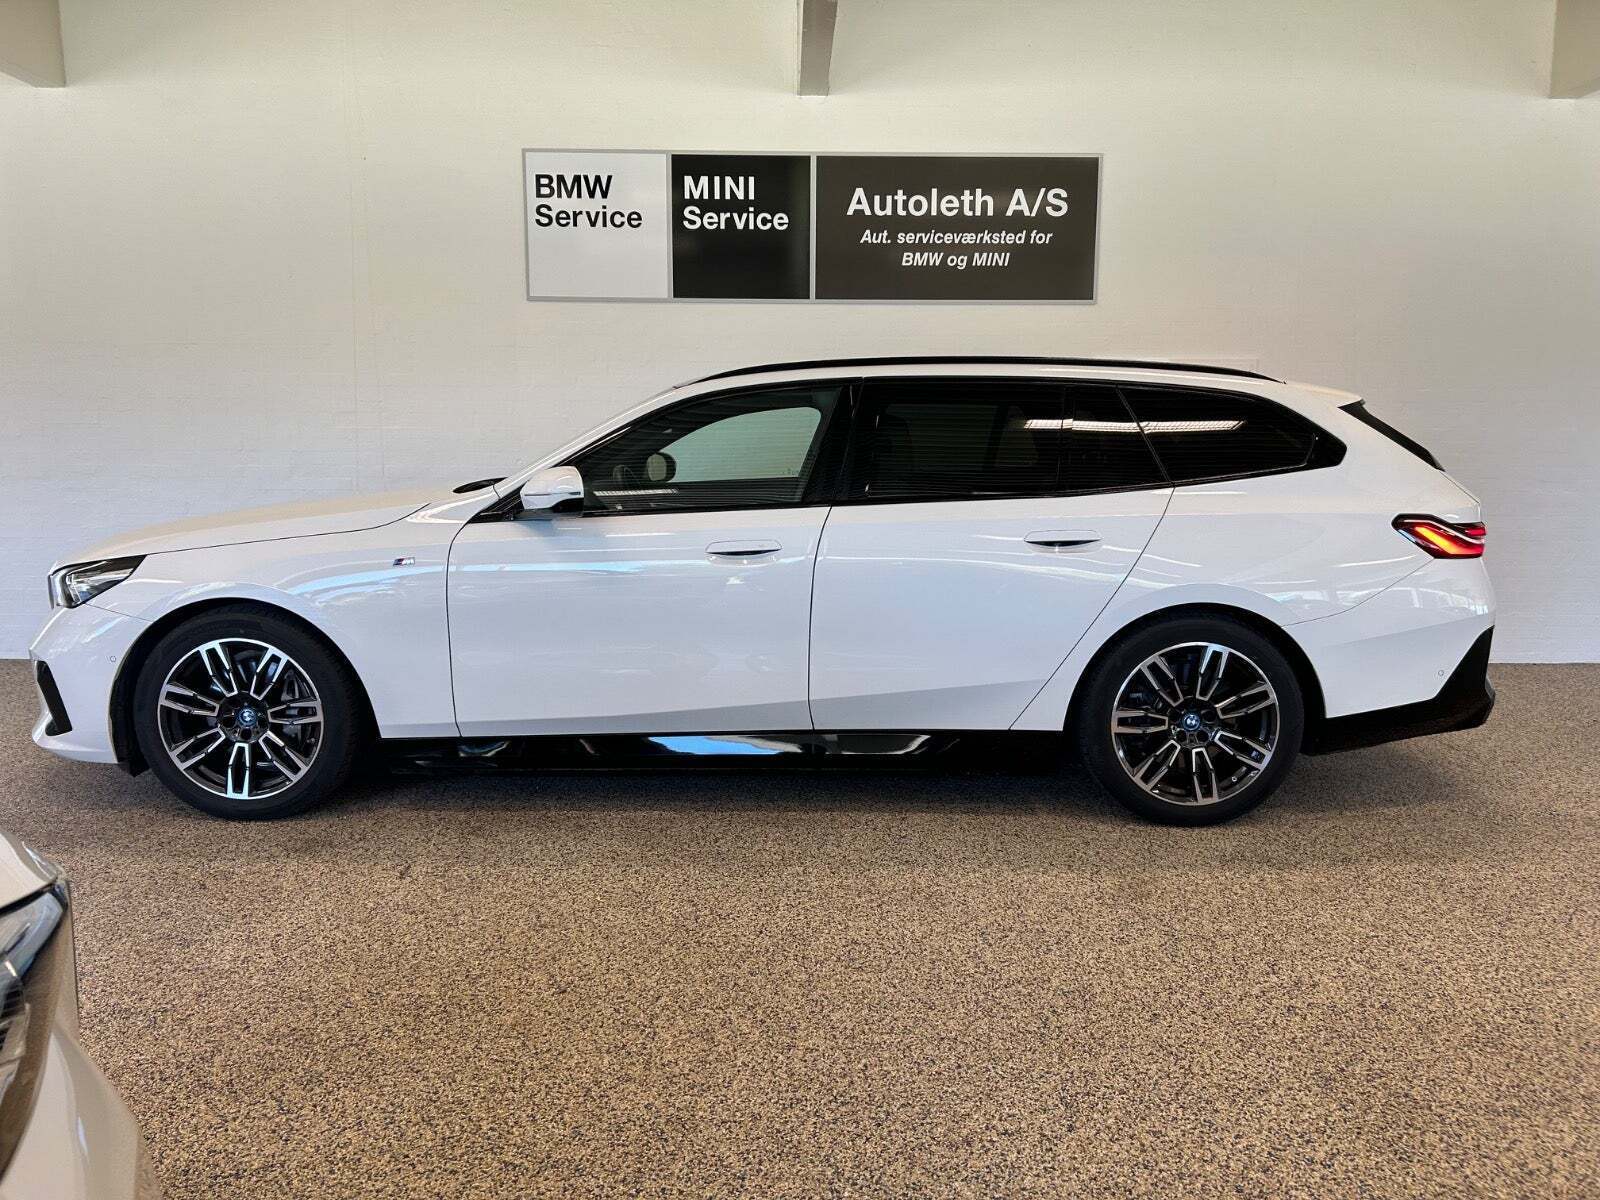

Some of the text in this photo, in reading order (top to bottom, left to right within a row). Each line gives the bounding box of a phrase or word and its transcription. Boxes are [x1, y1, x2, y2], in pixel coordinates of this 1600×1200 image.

[534, 174, 613, 199] BMW
[683, 175, 756, 200] MINI
[846, 187, 1069, 218] Autoleth A/S
[534, 203, 643, 229] Service
[682, 205, 790, 231] Service
[860, 229, 1053, 245] Aut. serviceværksted for
[901, 252, 1010, 270] BMW og MINI
